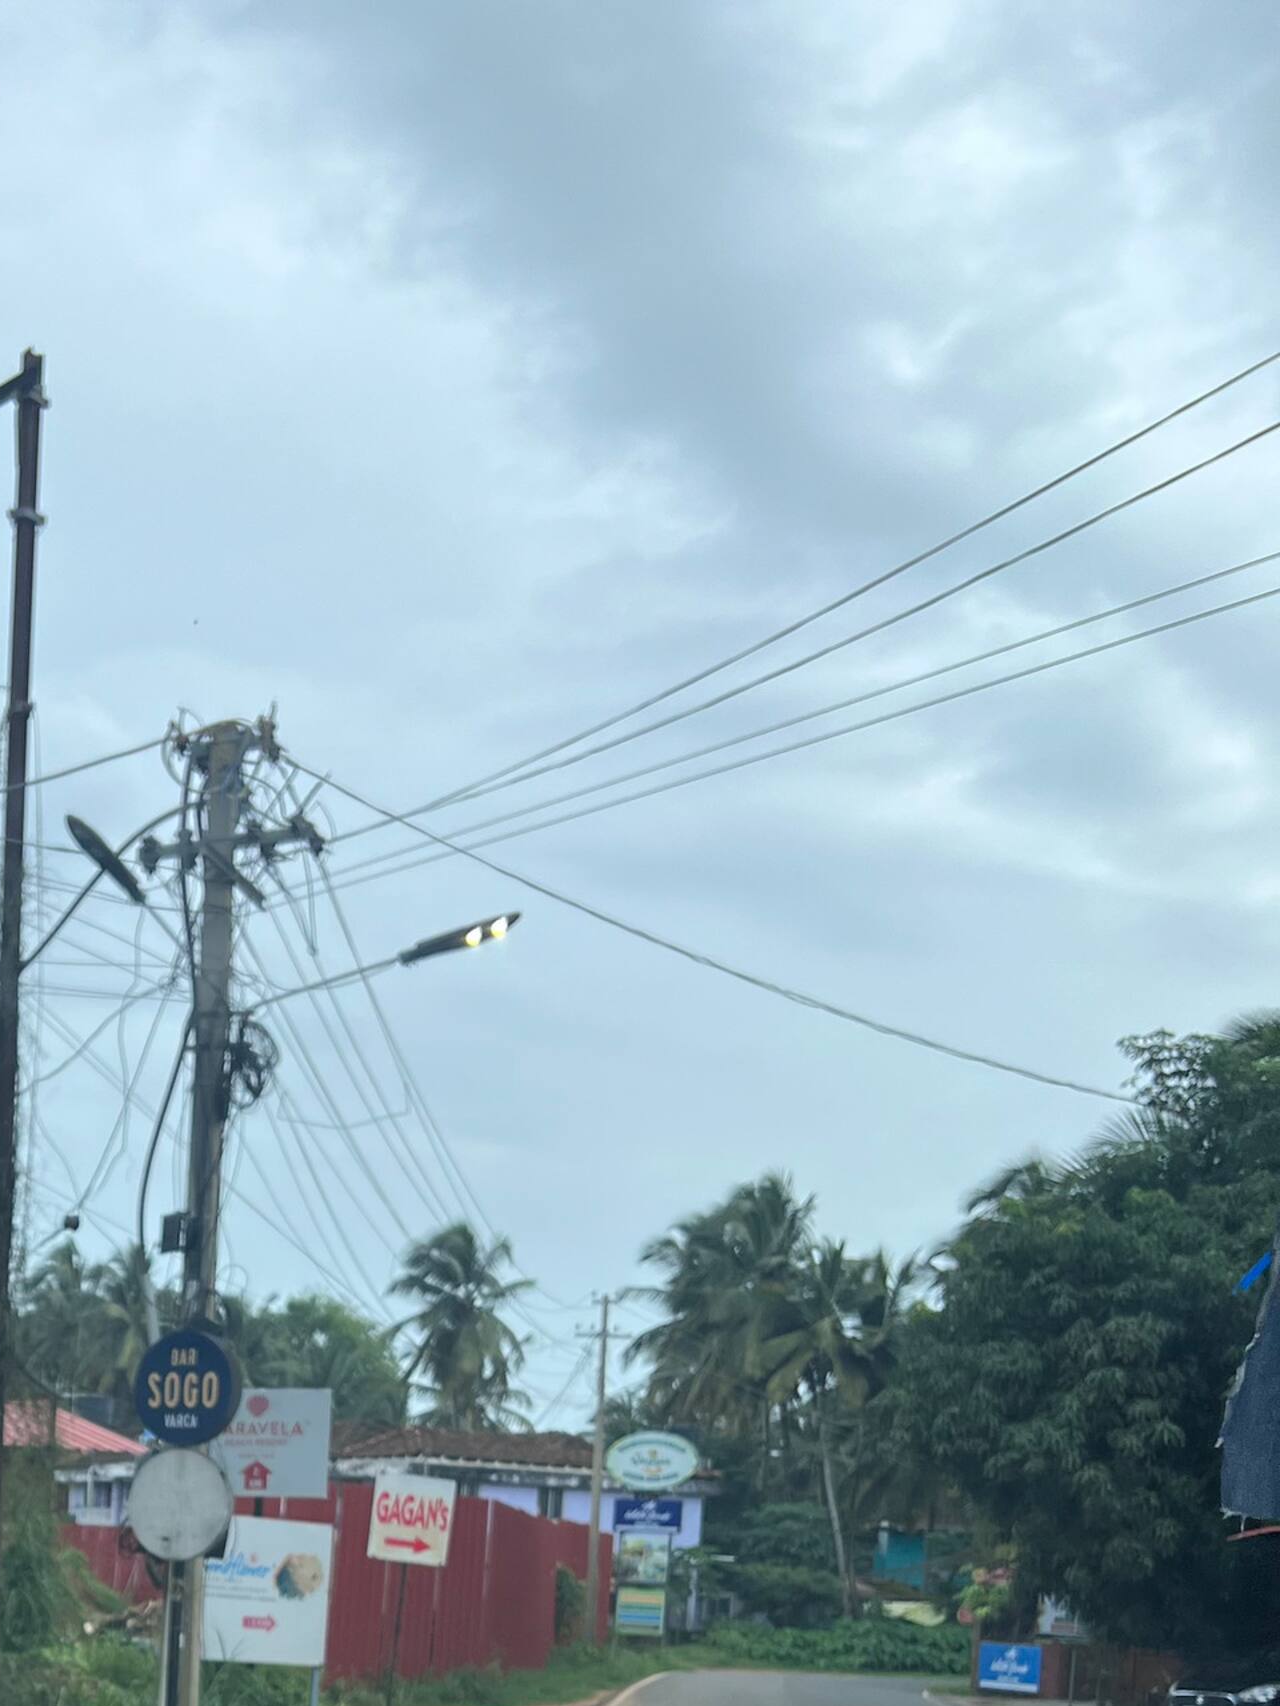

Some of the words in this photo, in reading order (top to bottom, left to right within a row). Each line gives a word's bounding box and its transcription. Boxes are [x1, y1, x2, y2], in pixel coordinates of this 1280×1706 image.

[170, 1347, 197, 1366] BAR
[147, 1371, 220, 1408] SOGO
[164, 1413, 199, 1429] VARCA
[223, 1420, 304, 1436] ARAVELA
